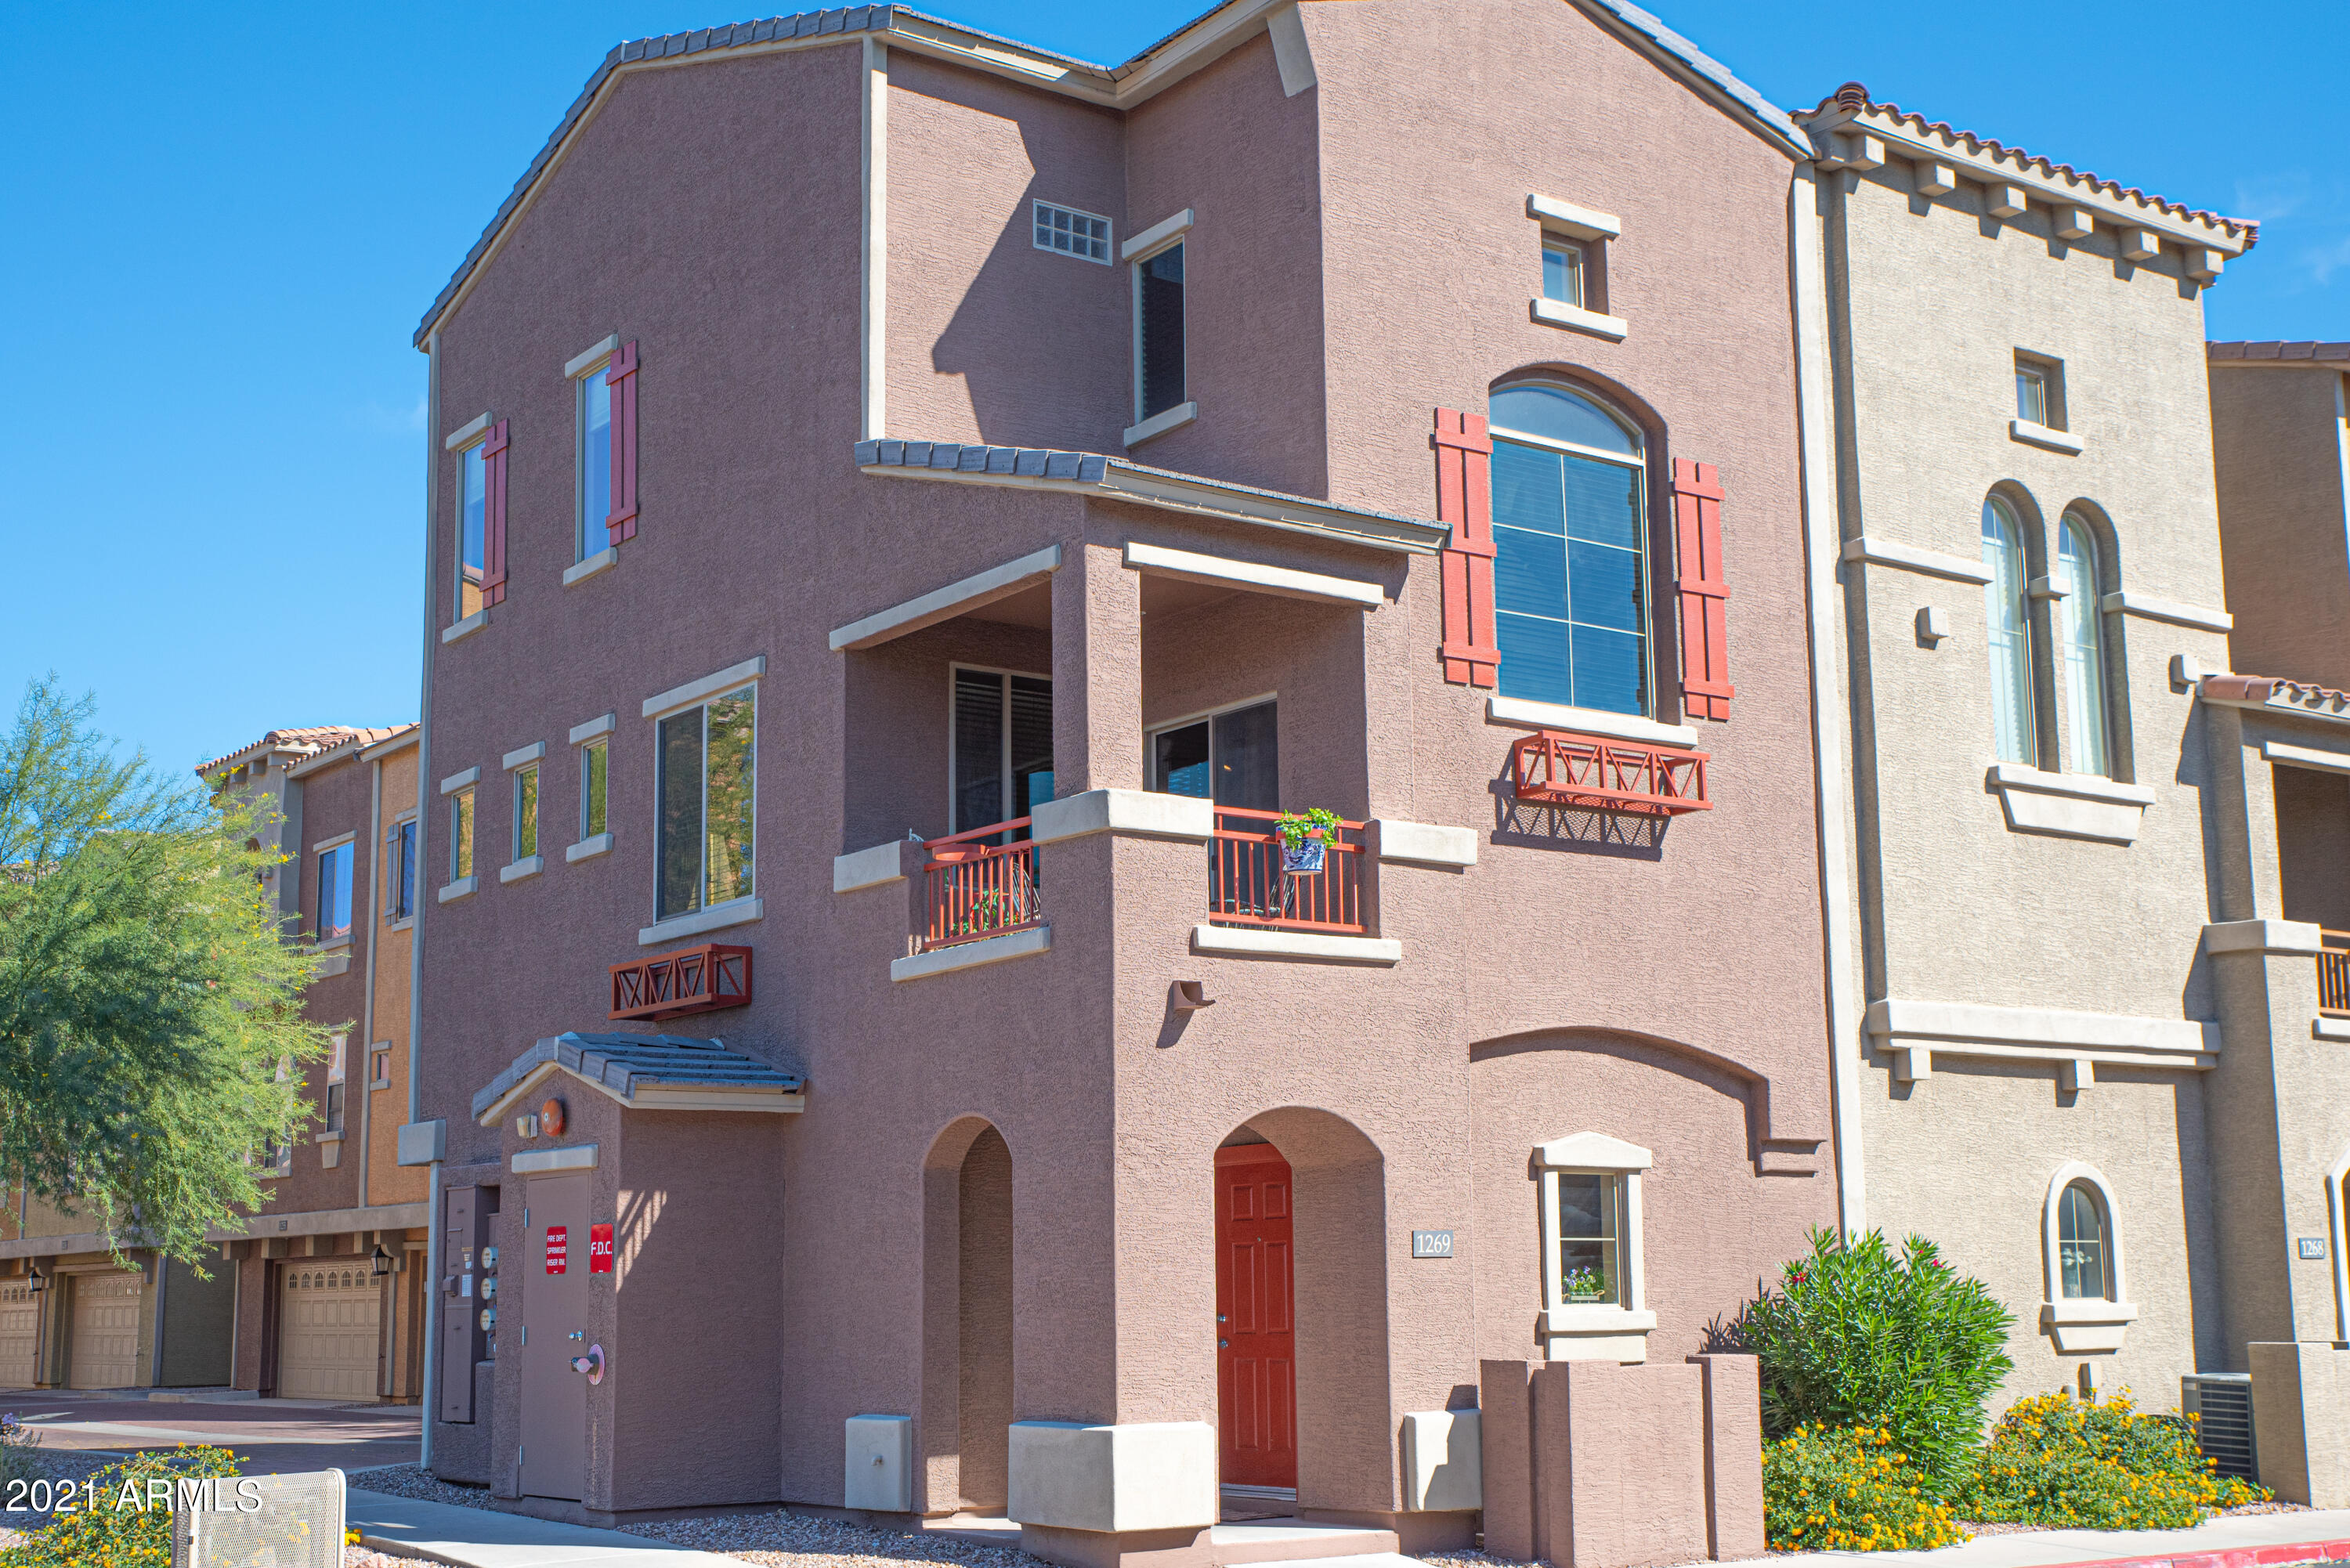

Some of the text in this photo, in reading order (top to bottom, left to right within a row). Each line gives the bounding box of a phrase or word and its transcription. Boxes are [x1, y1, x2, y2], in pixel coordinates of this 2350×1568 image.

[591, 1241, 613, 1255] F.D.C.
[1417, 1234, 1451, 1253] 1269
[2301, 1240, 2324, 1255] 1268
